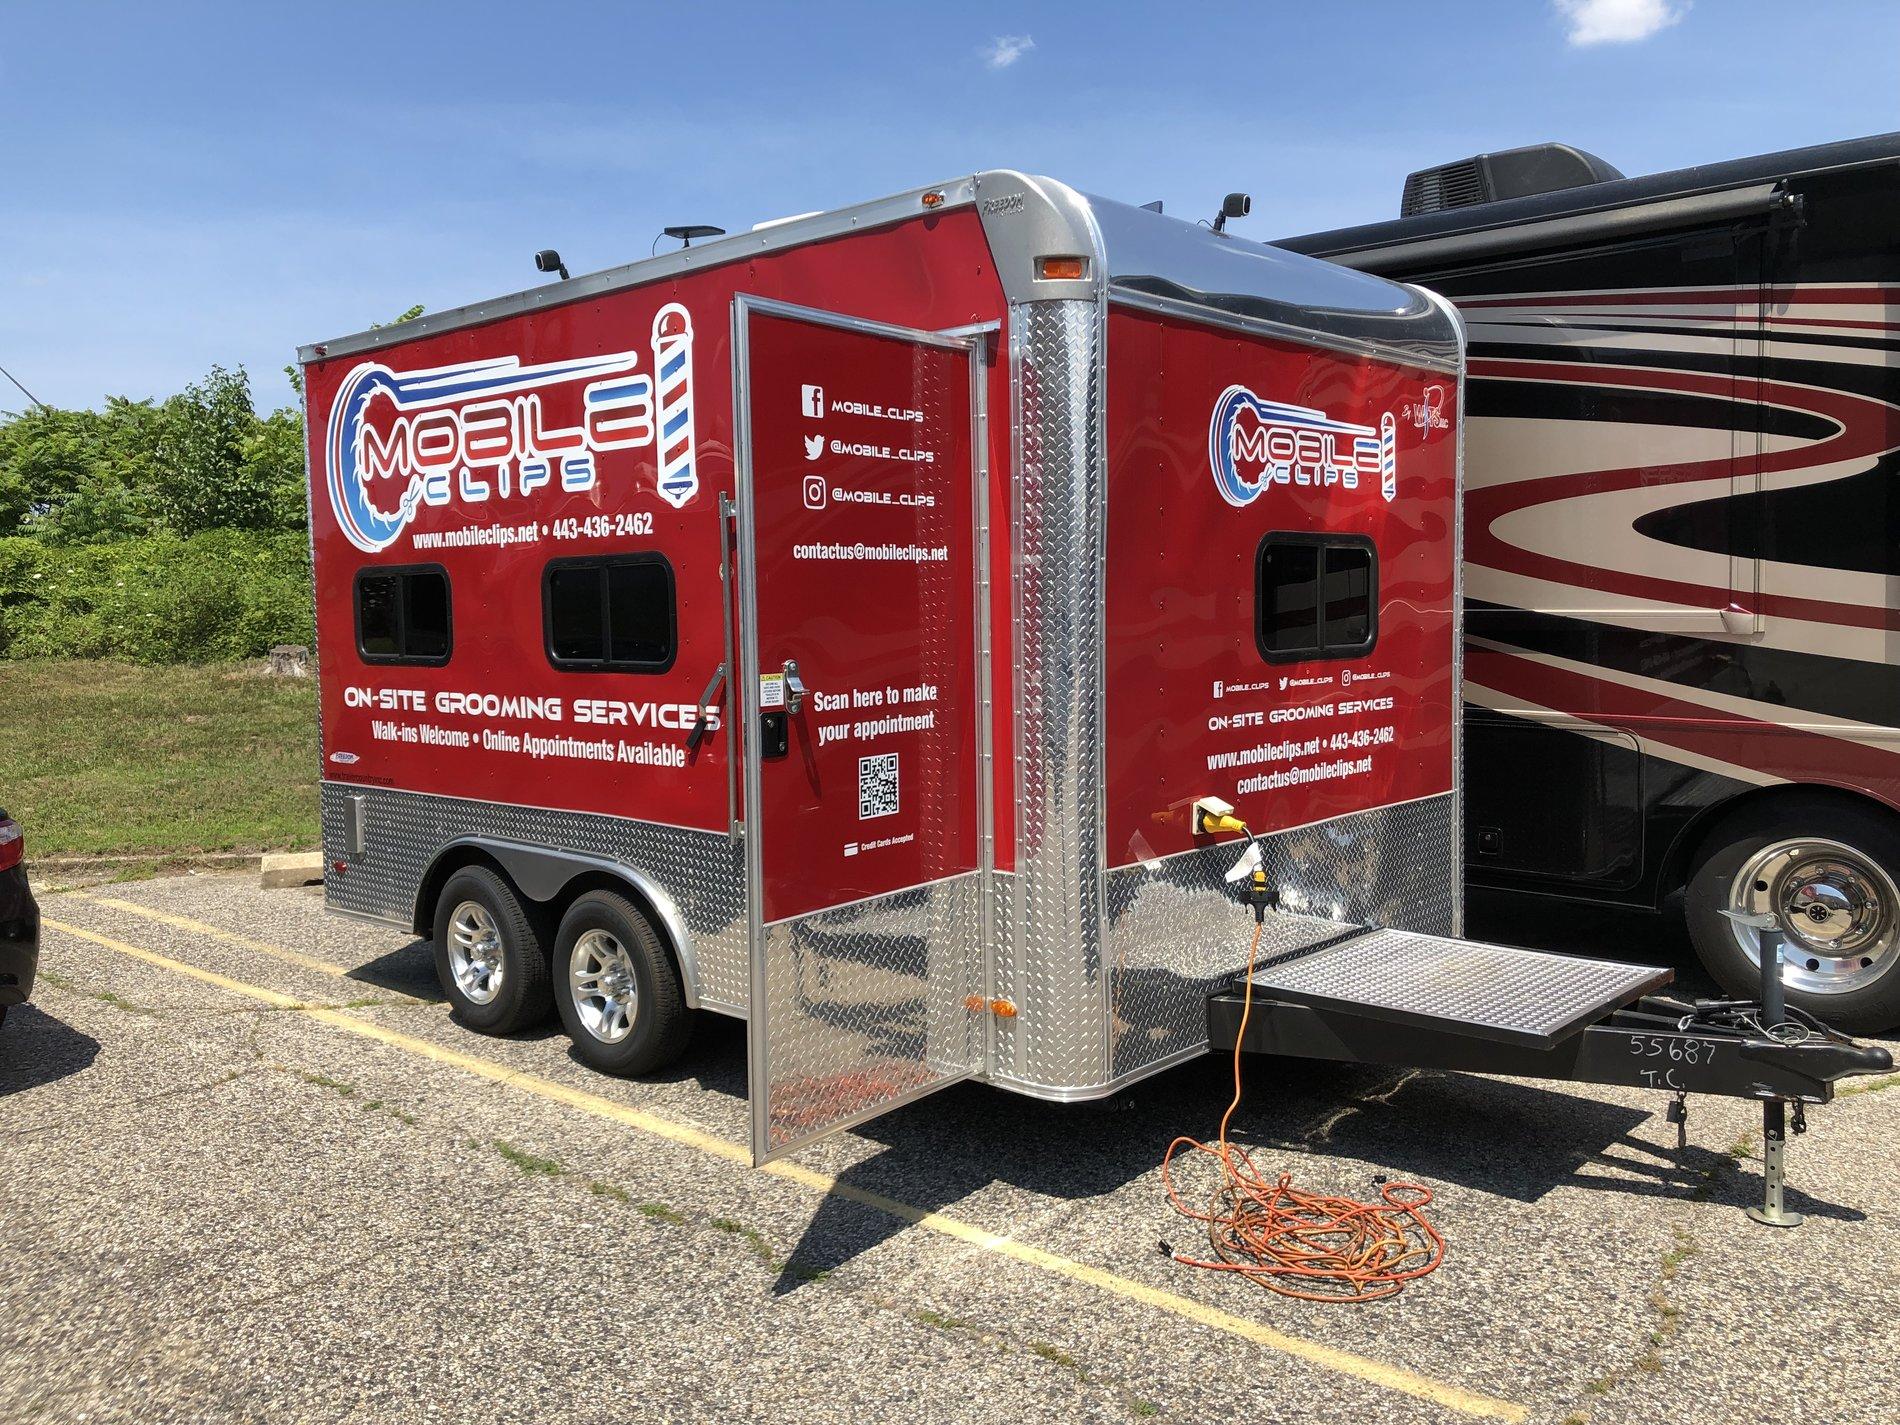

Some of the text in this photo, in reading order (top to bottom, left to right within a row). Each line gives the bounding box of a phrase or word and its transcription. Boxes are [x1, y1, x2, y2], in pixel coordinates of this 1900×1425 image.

[832, 400, 924, 422] MOBILE_CLIPS
[360, 373, 654, 481] MOBILE
[830, 439, 934, 462] @MOBILE_CLIPS
[1232, 424, 1382, 473] MOBILE
[423, 451, 596, 506] CLIPS
[1274, 461, 1359, 489] CLIPS
[832, 488, 935, 507] @MOBILE_CLIPS
[412, 512, 654, 549] www.mobileclips.net 443-436-2462
[793, 542, 948, 563] contactus@mobileclips.net
[1226, 682, 1270, 693] MOBILE_CLIPS
[1289, 676, 1333, 687] @MOBILE_CLIPS
[1352, 671, 1391, 682] @MOBILE_CLIPS
[344, 686, 721, 732] ON-SITE GROOMING SERVICES
[814, 683, 937, 712] Scan here to make
[818, 711, 935, 746] your appointment
[1208, 697, 1394, 731] ON-SITE GROOMING SERVICES
[371, 720, 685, 768] Walk-ins Welcome Online Appointments Available
[1207, 726, 1394, 771] www.mobileclips.net 443-436-2462
[1237, 755, 1372, 795] contactus@mobileclips.net
[861, 833, 914, 851] Credit Cards Accepted
[1630, 1035, 1716, 1065] 55687
